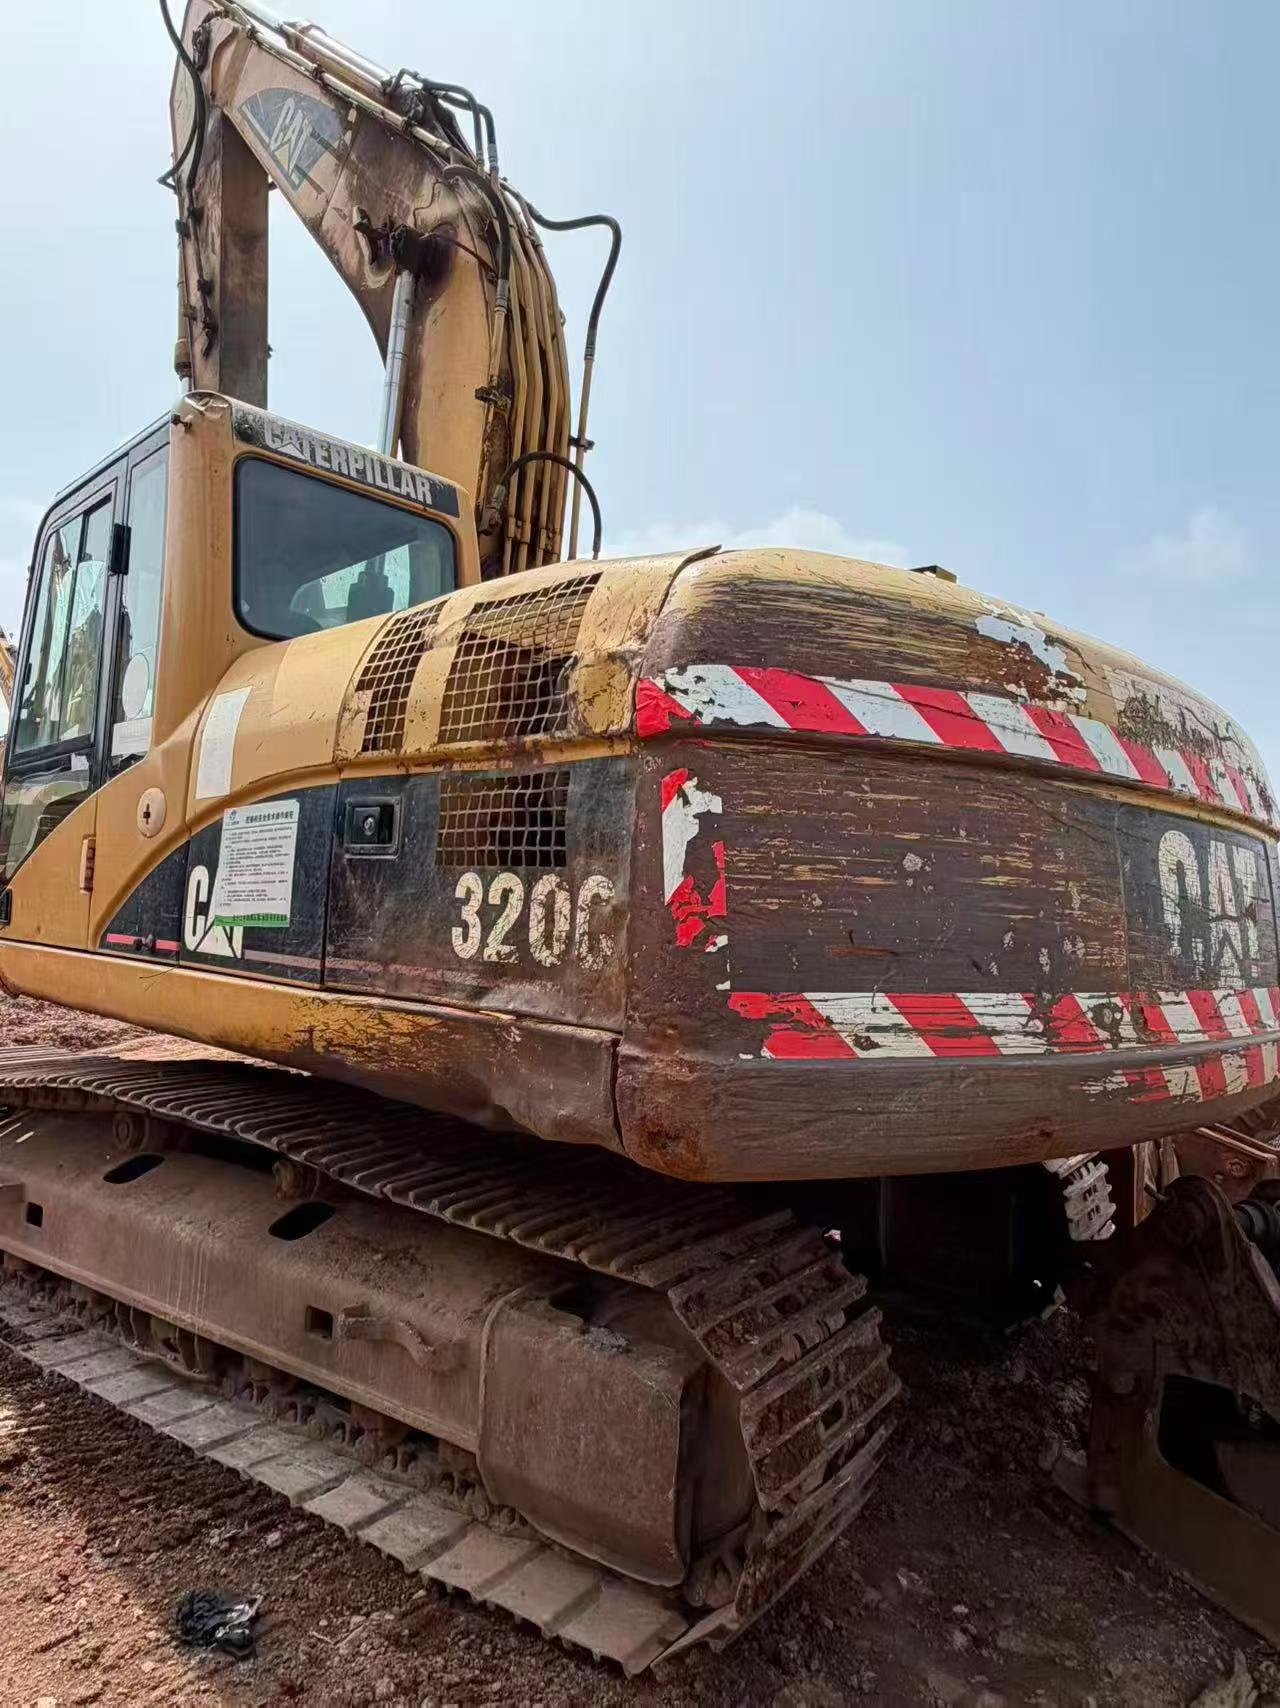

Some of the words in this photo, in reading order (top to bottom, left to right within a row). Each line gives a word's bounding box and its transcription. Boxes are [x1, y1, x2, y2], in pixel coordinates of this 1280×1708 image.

[270, 97, 314, 177] CAT
[264, 418, 433, 505] CATERPILLAR
[452, 871, 616, 971] 320C
